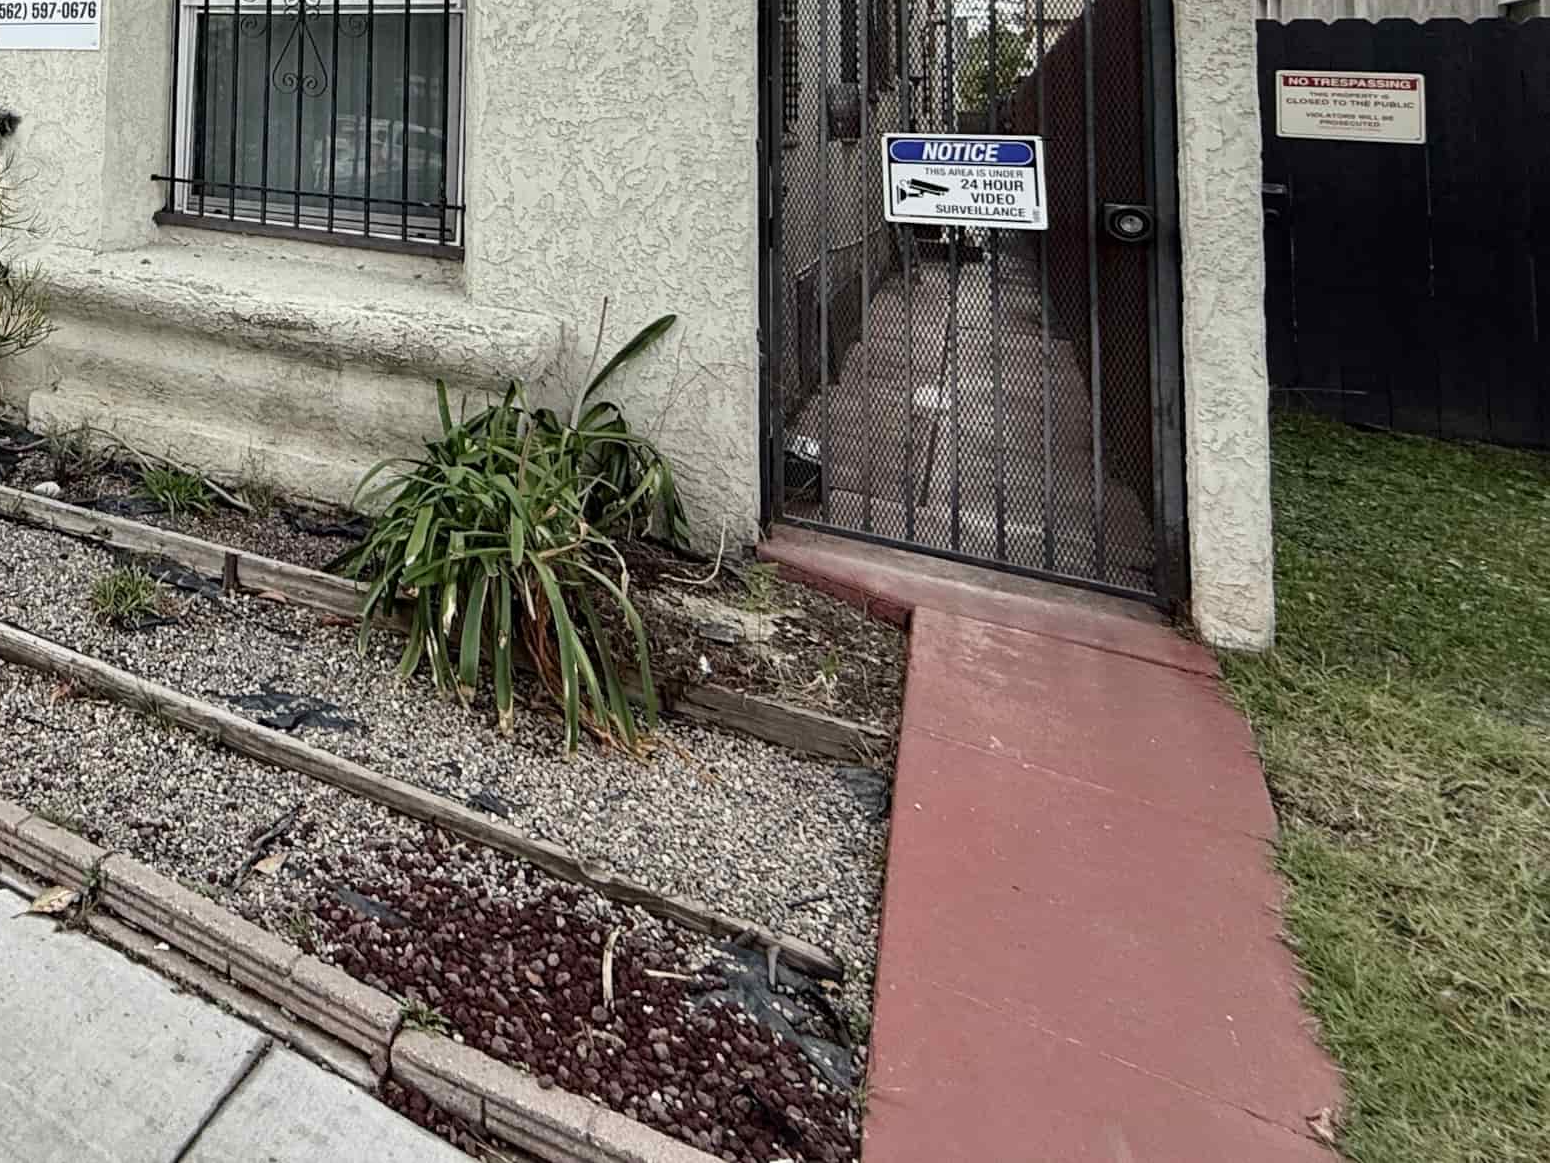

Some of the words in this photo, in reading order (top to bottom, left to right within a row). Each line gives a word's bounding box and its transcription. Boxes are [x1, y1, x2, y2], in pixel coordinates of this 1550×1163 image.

[32, 1, 97, 19] 597-0676
[1288, 77, 1309, 86] NO
[1314, 78, 1411, 89] TRESPASSING
[1331, 92, 1379, 100] PROPERTY
[1286, 98, 1329, 106] CLOSED
[1332, 99, 1347, 107] TO
[1350, 100, 1371, 108] THE
[1373, 101, 1416, 110] PUBLIC
[1306, 112, 1356, 120] VIOLATORS
[1319, 119, 1381, 127] PROSECUTED
[922, 141, 1000, 162] NOTICE
[924, 167, 946, 177] THIS
[949, 168, 975, 178] AREA
[976, 169, 987, 178] IS
[988, 169, 1024, 179] UNDER
[960, 178, 979, 190] 24
[982, 179, 1024, 192] HOUR
[970, 192, 1016, 205] VIDEO
[935, 204, 1026, 218] SURVEILLANCE
